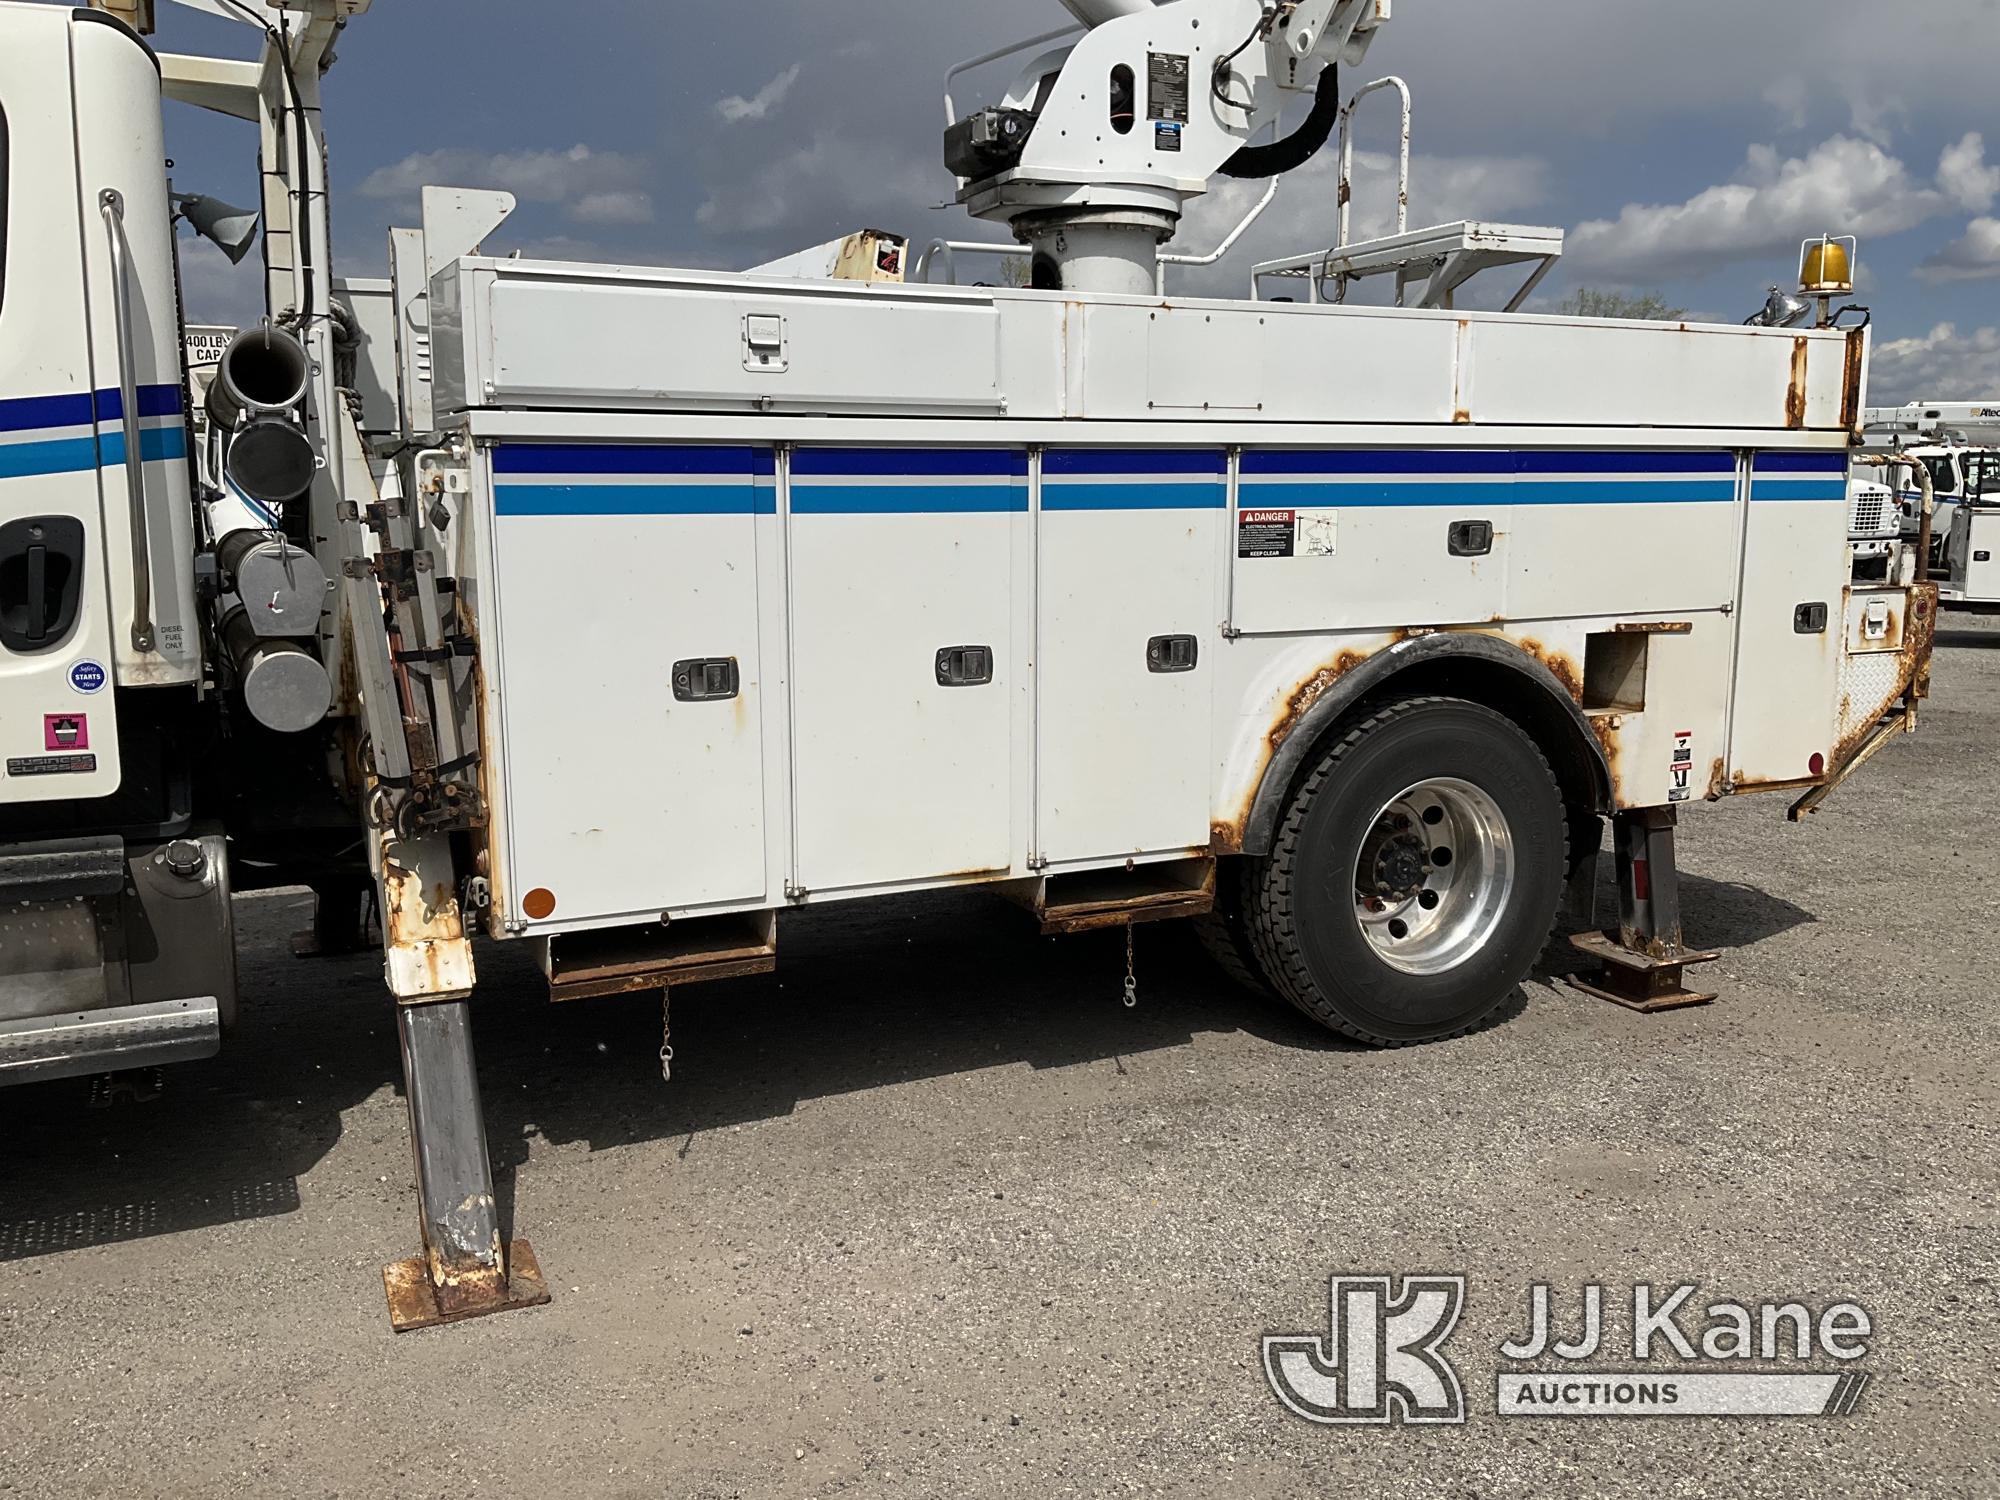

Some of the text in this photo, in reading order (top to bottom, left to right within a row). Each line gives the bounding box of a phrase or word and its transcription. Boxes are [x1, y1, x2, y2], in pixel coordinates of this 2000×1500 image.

[186, 335, 207, 348] 400
[196, 349, 221, 361] CAP
[1254, 512, 1289, 522] DANGER
[161, 625, 185, 633] DIESEL
[165, 641, 183, 649] ONLY
[75, 673, 101, 681] STARTS
[8, 755, 94, 767] BUSINESS
[10, 764, 71, 773] CLASS
